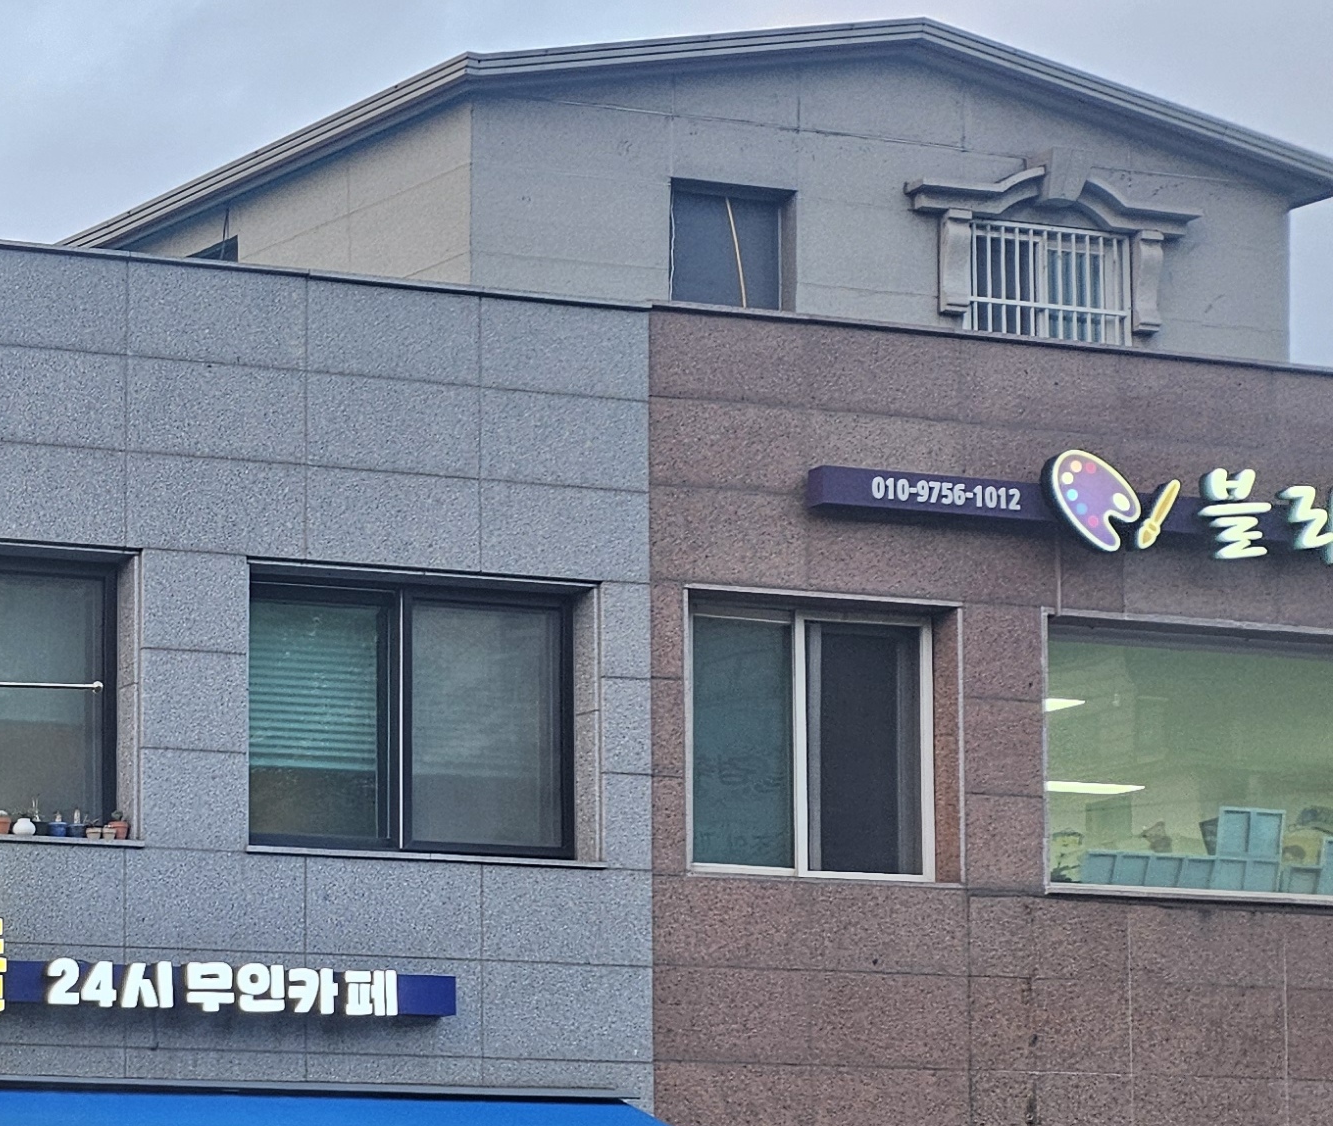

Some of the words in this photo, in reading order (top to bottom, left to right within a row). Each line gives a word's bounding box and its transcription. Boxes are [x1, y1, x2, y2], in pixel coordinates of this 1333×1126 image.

[871, 476, 1021, 511] 010-9756-1012
[46, 957, 174, 1009] 24시
[186, 960, 398, 1017] 무인카페
